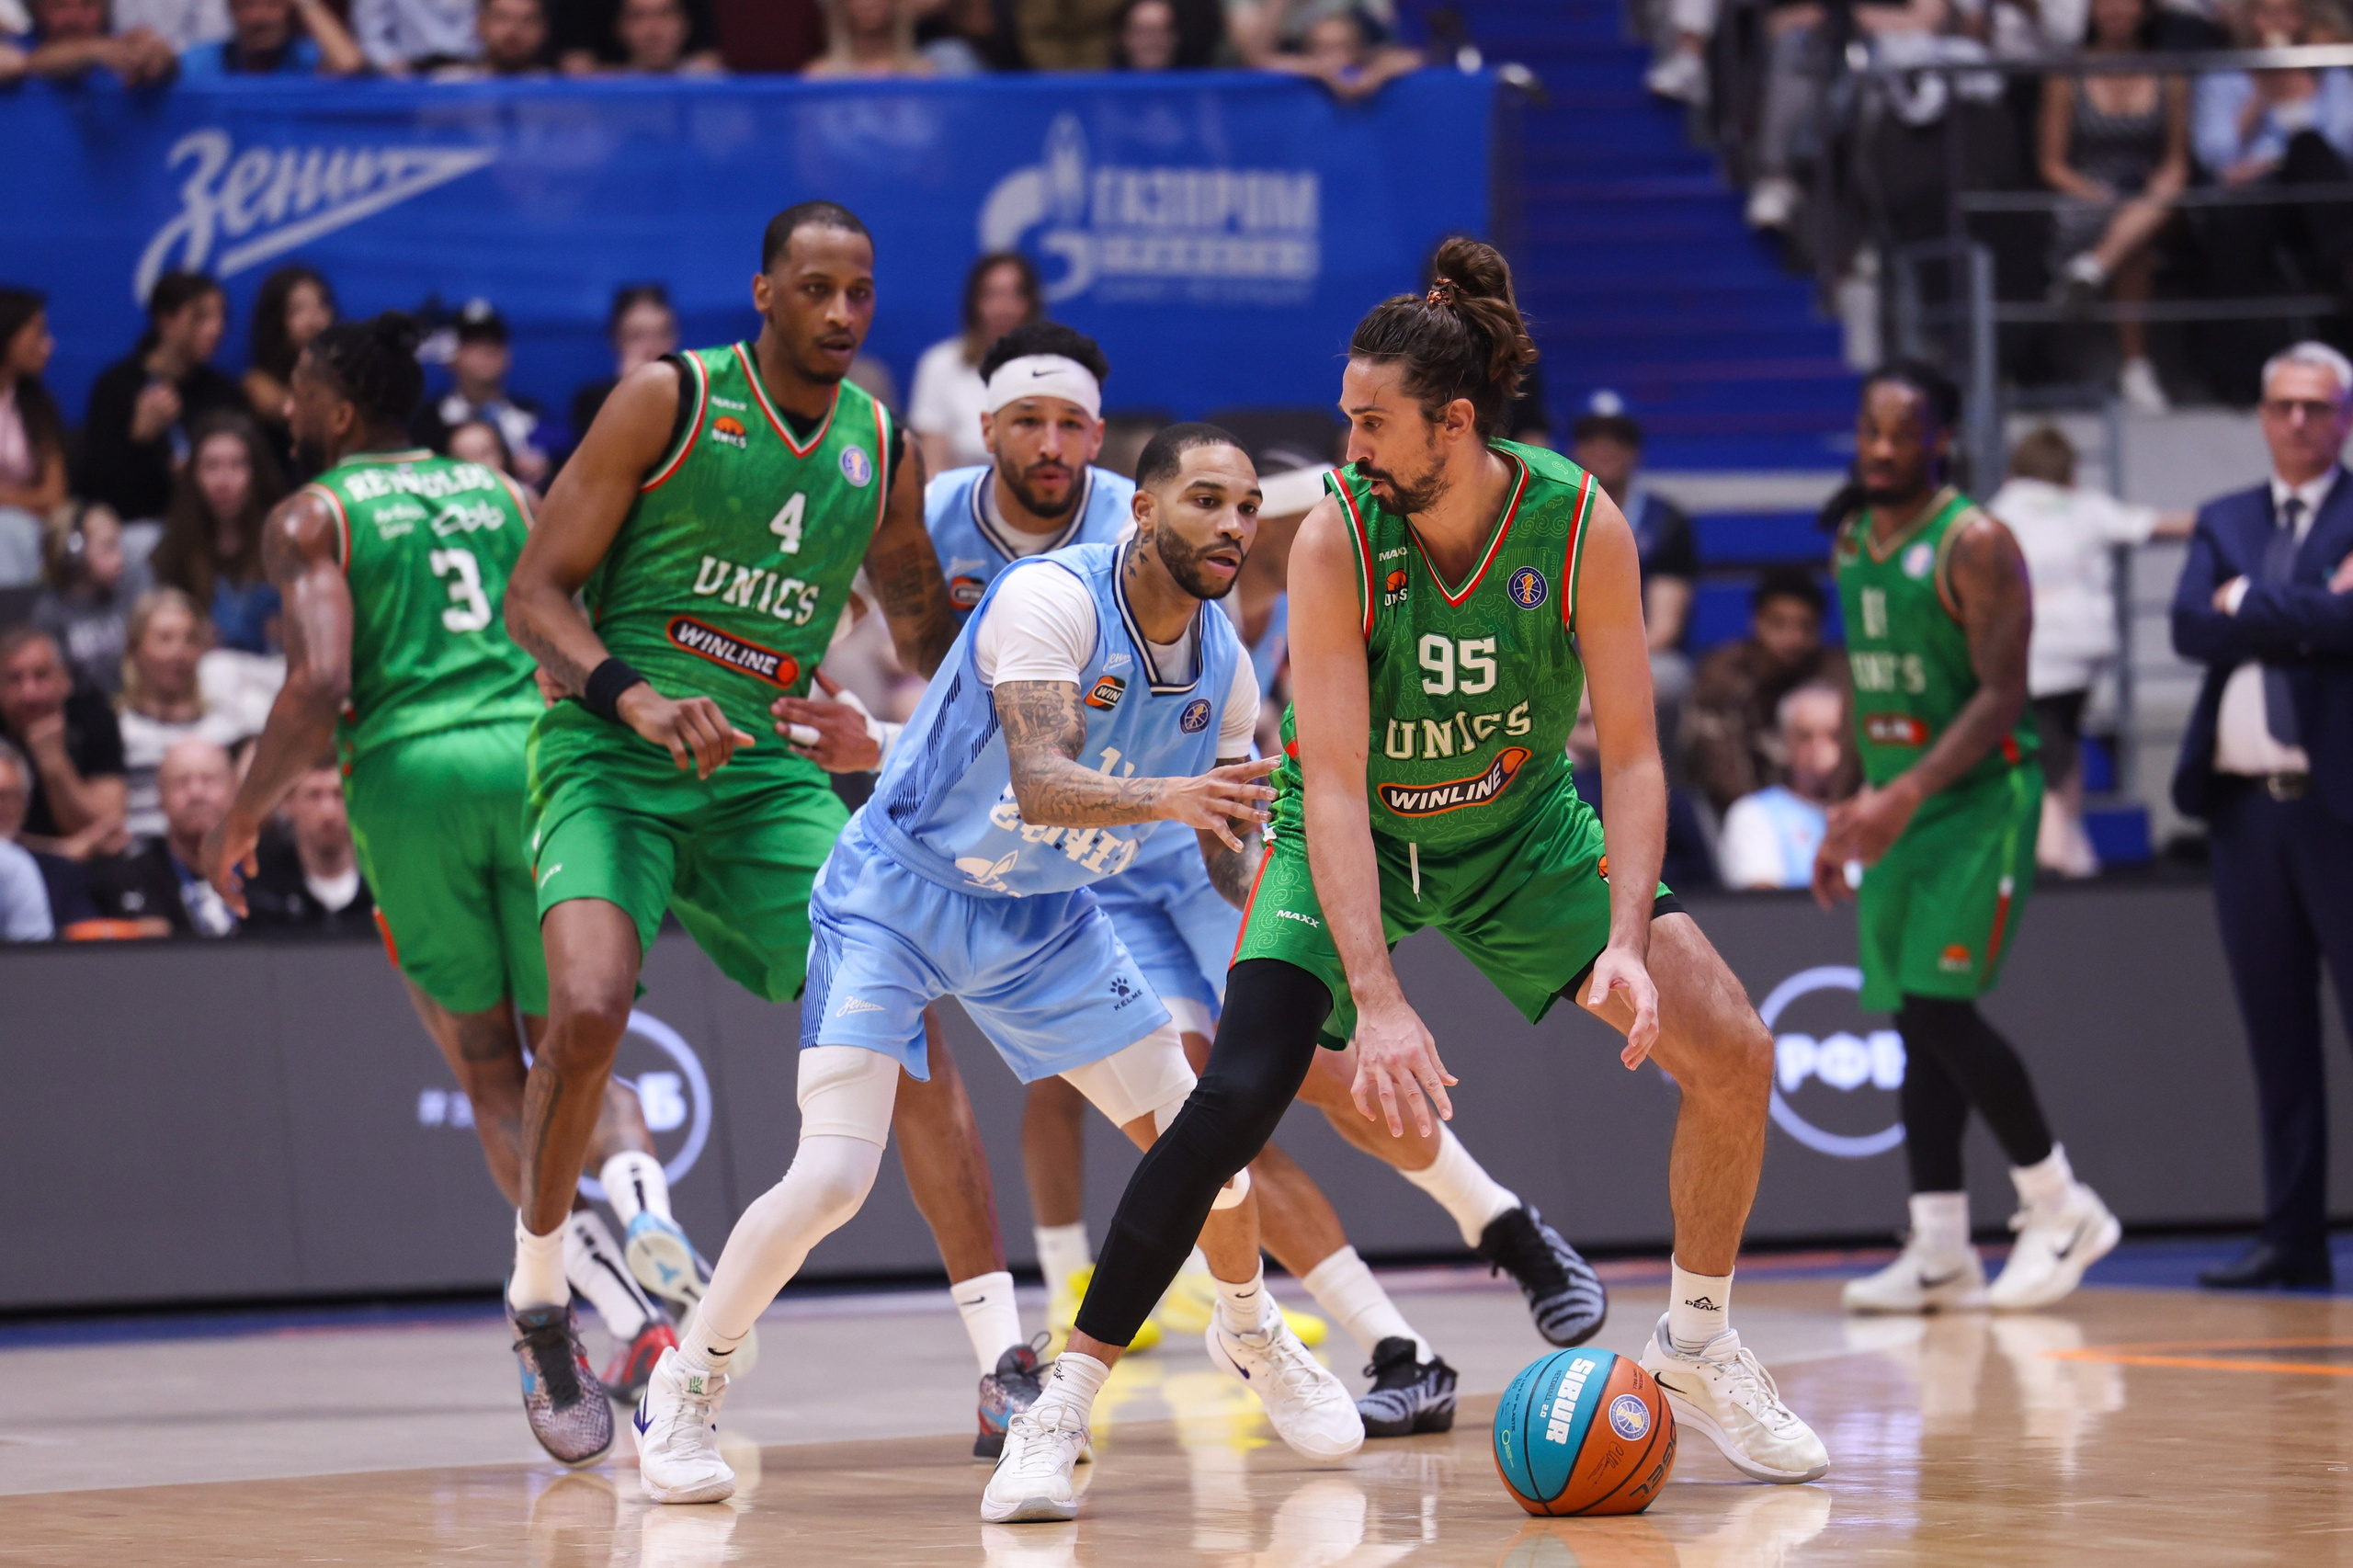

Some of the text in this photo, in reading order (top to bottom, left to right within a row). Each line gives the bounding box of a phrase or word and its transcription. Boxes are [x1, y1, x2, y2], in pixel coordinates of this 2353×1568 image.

[768, 490, 807, 554] 4
[428, 547, 494, 634] 3
[692, 554, 820, 626] UNICS
[676, 621, 779, 676] WINLINE
[1418, 632, 1497, 697] 95
[1097, 686, 1122, 702] WIN
[1385, 696, 1531, 760] UNICS
[1391, 761, 1502, 810] WINLINE
[1276, 909, 1320, 928] MAXX
[1113, 989, 1142, 1011] KELME
[1539, 1403, 1550, 1418] 2.0
[1545, 1357, 1597, 1445] SIBUR
